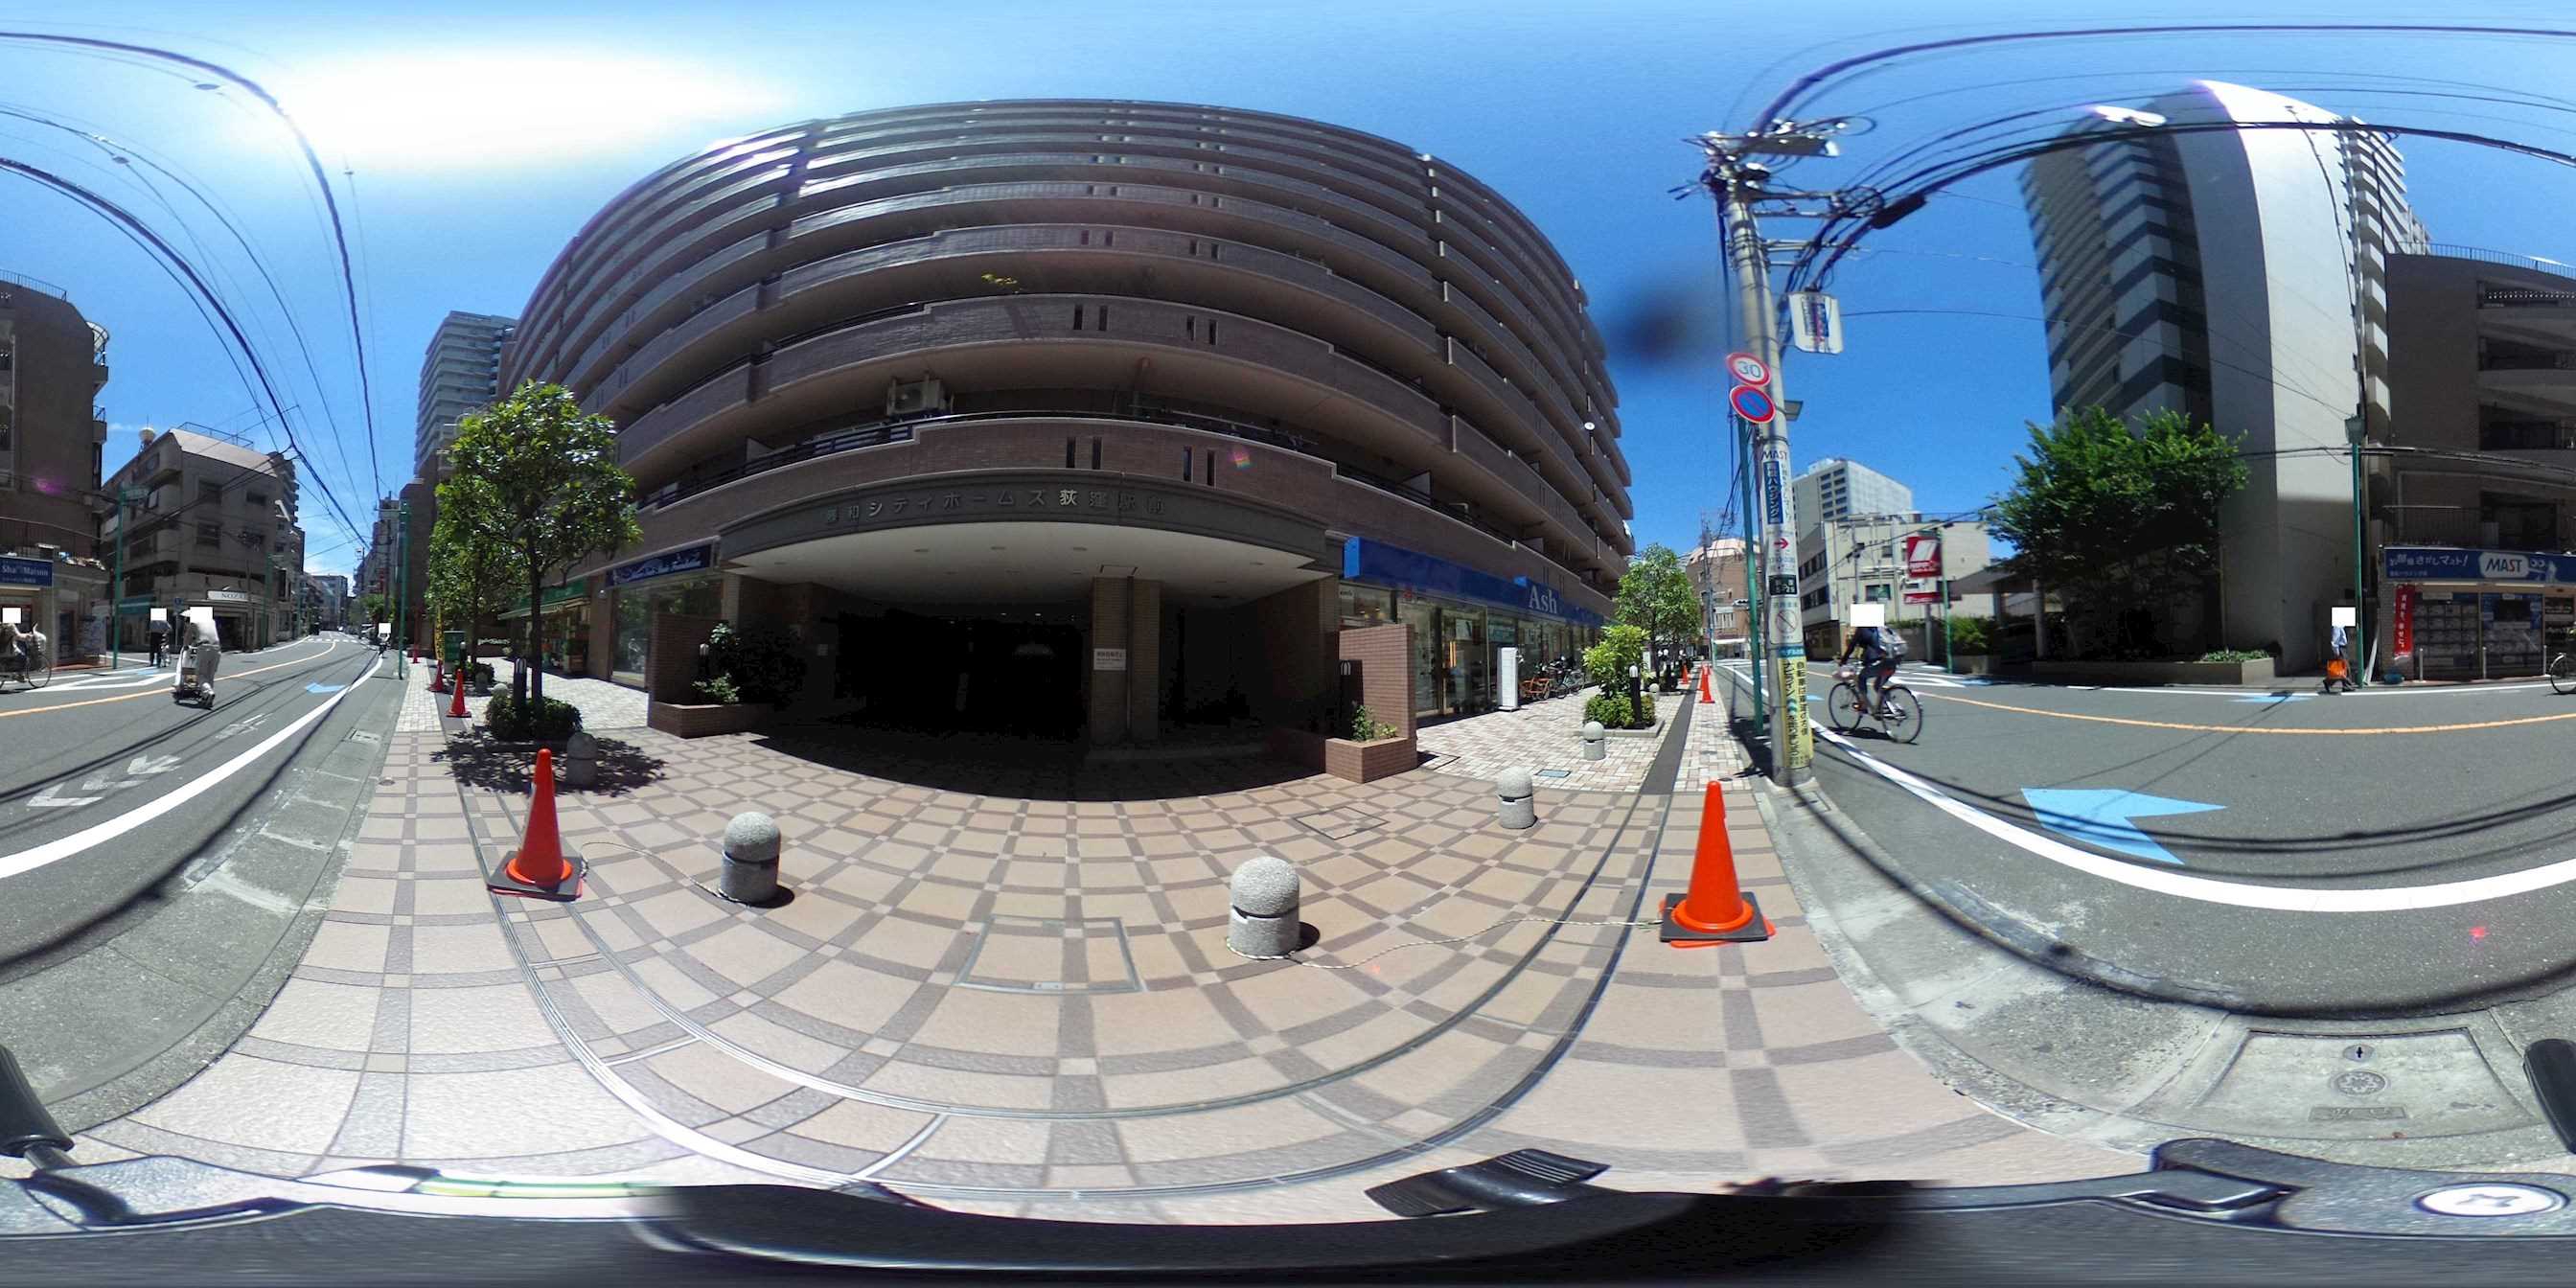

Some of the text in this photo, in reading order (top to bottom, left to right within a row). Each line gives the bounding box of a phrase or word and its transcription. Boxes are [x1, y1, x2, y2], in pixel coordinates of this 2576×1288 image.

[1736, 360, 1761, 379] 30
[2485, 557, 2523, 573] MAST
[1528, 585, 1557, 614] Ash
